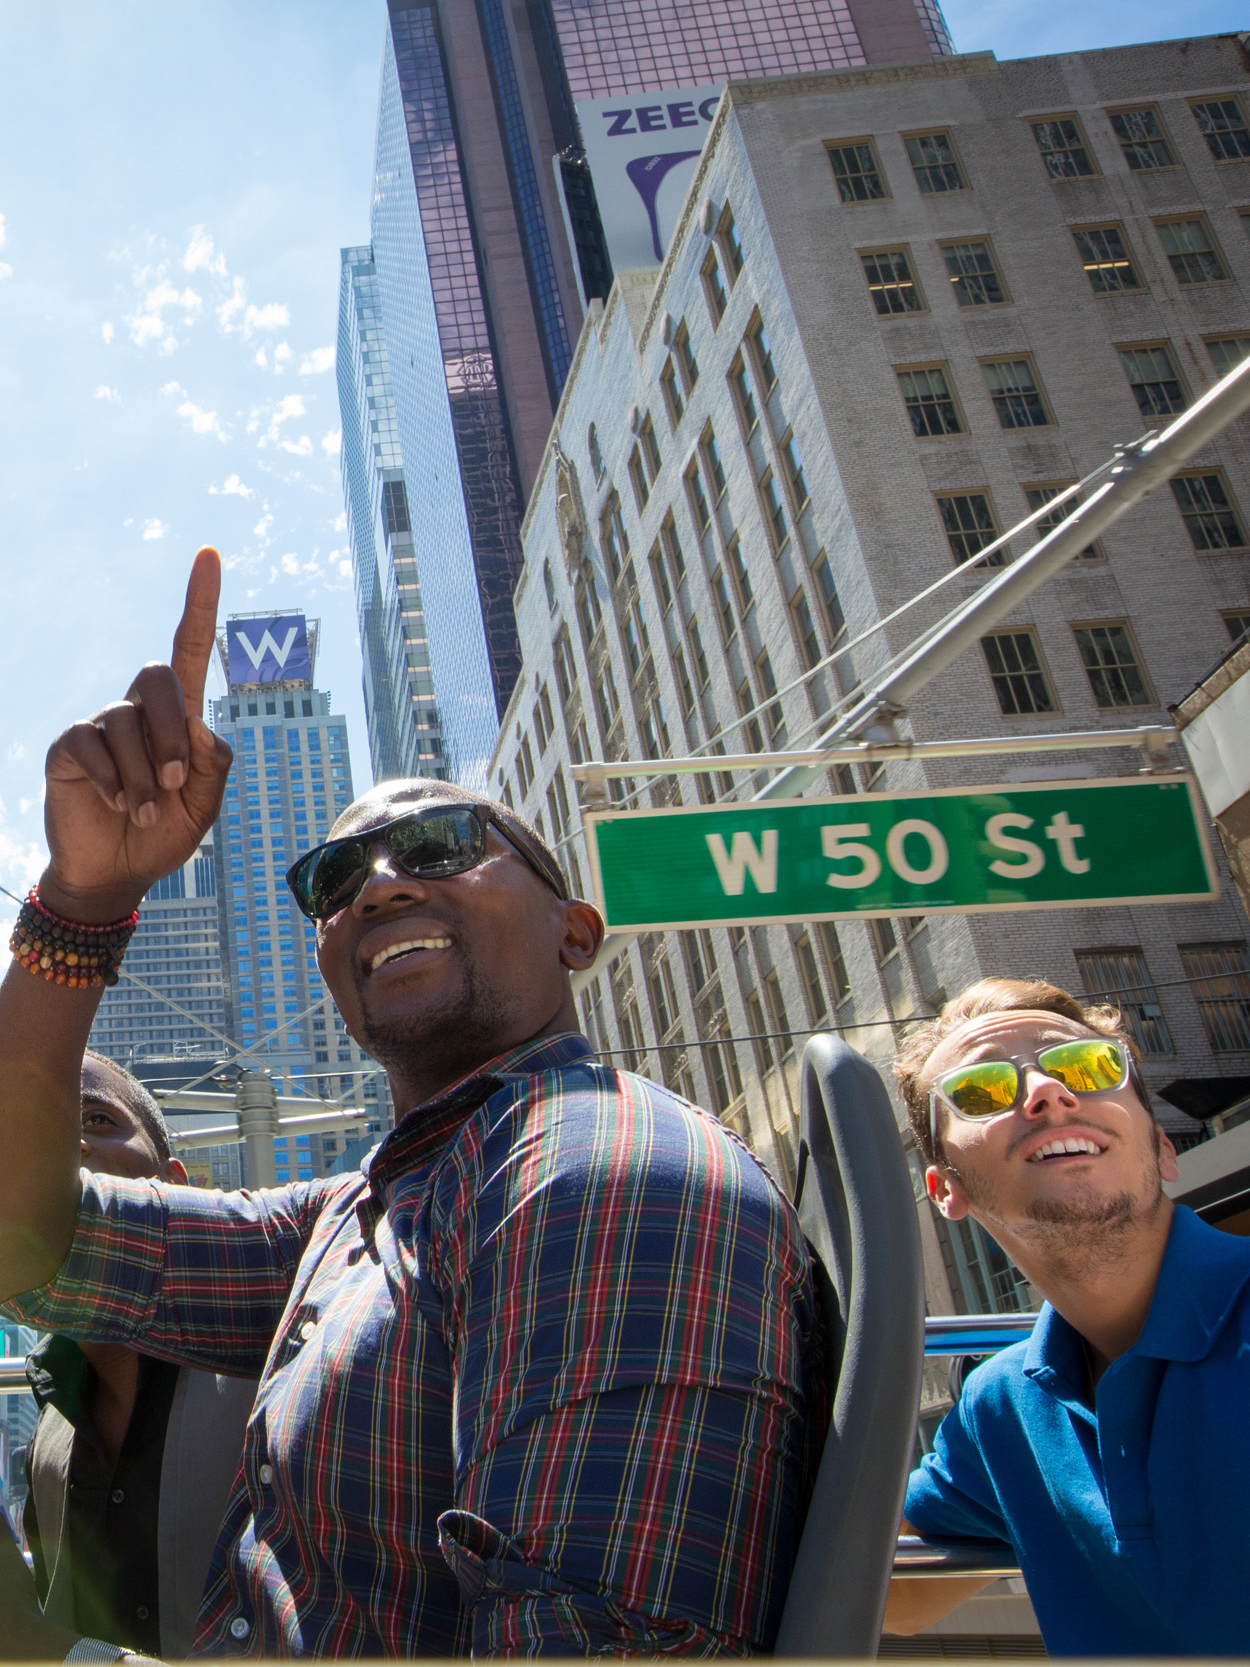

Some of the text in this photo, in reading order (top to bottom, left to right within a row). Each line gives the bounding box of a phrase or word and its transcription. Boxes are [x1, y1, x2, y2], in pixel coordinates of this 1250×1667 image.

[235, 627, 299, 670] W
[705, 810, 1091, 895] W 50 St
